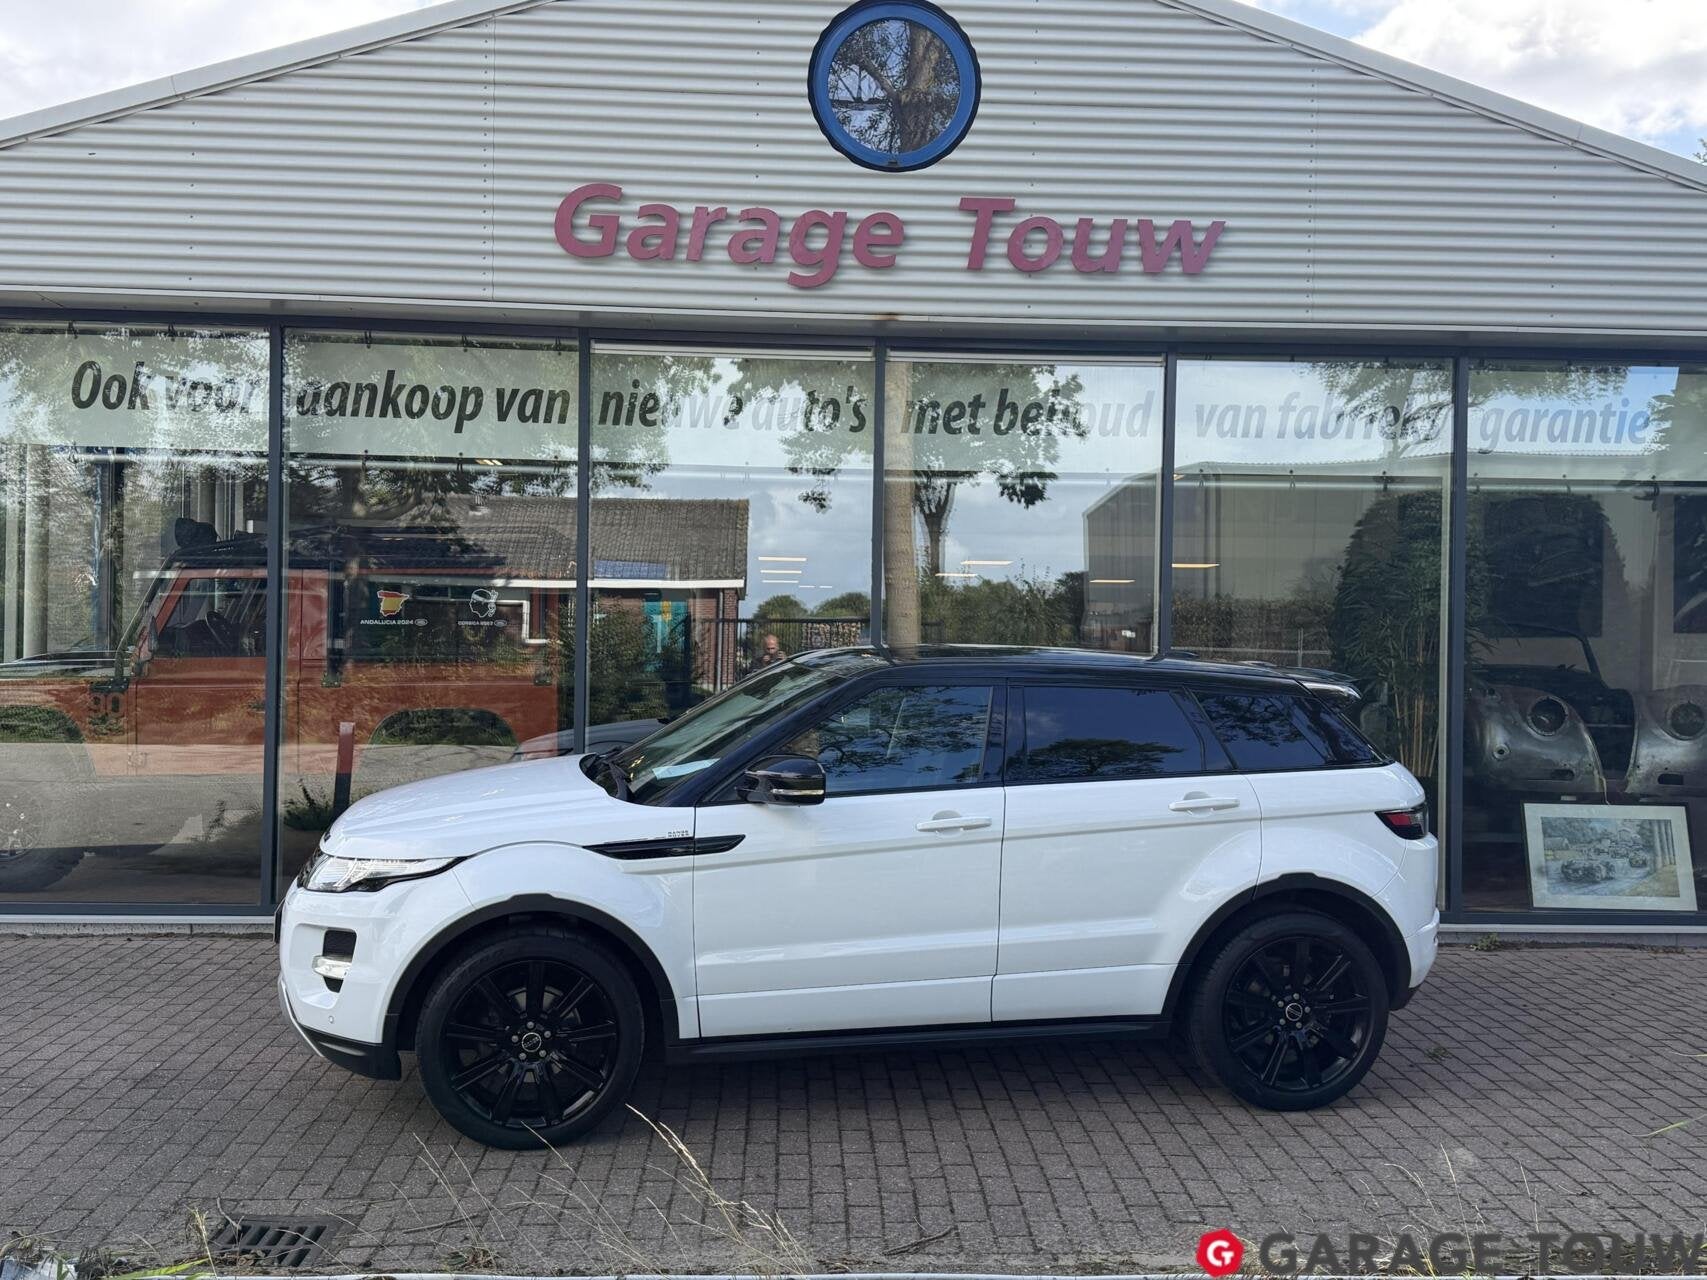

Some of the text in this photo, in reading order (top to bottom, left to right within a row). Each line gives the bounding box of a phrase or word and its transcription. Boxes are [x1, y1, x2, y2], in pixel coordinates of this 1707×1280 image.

[554, 182, 1226, 289] Garage Touw
[71, 360, 151, 411] Ook
[296, 369, 484, 434] aankoop
[496, 387, 571, 425] van
[598, 378, 744, 431] nieuwe
[752, 385, 868, 433] auto's
[901, 393, 986, 436] met
[1195, 402, 1268, 440] van
[1479, 397, 1651, 454] garantie
